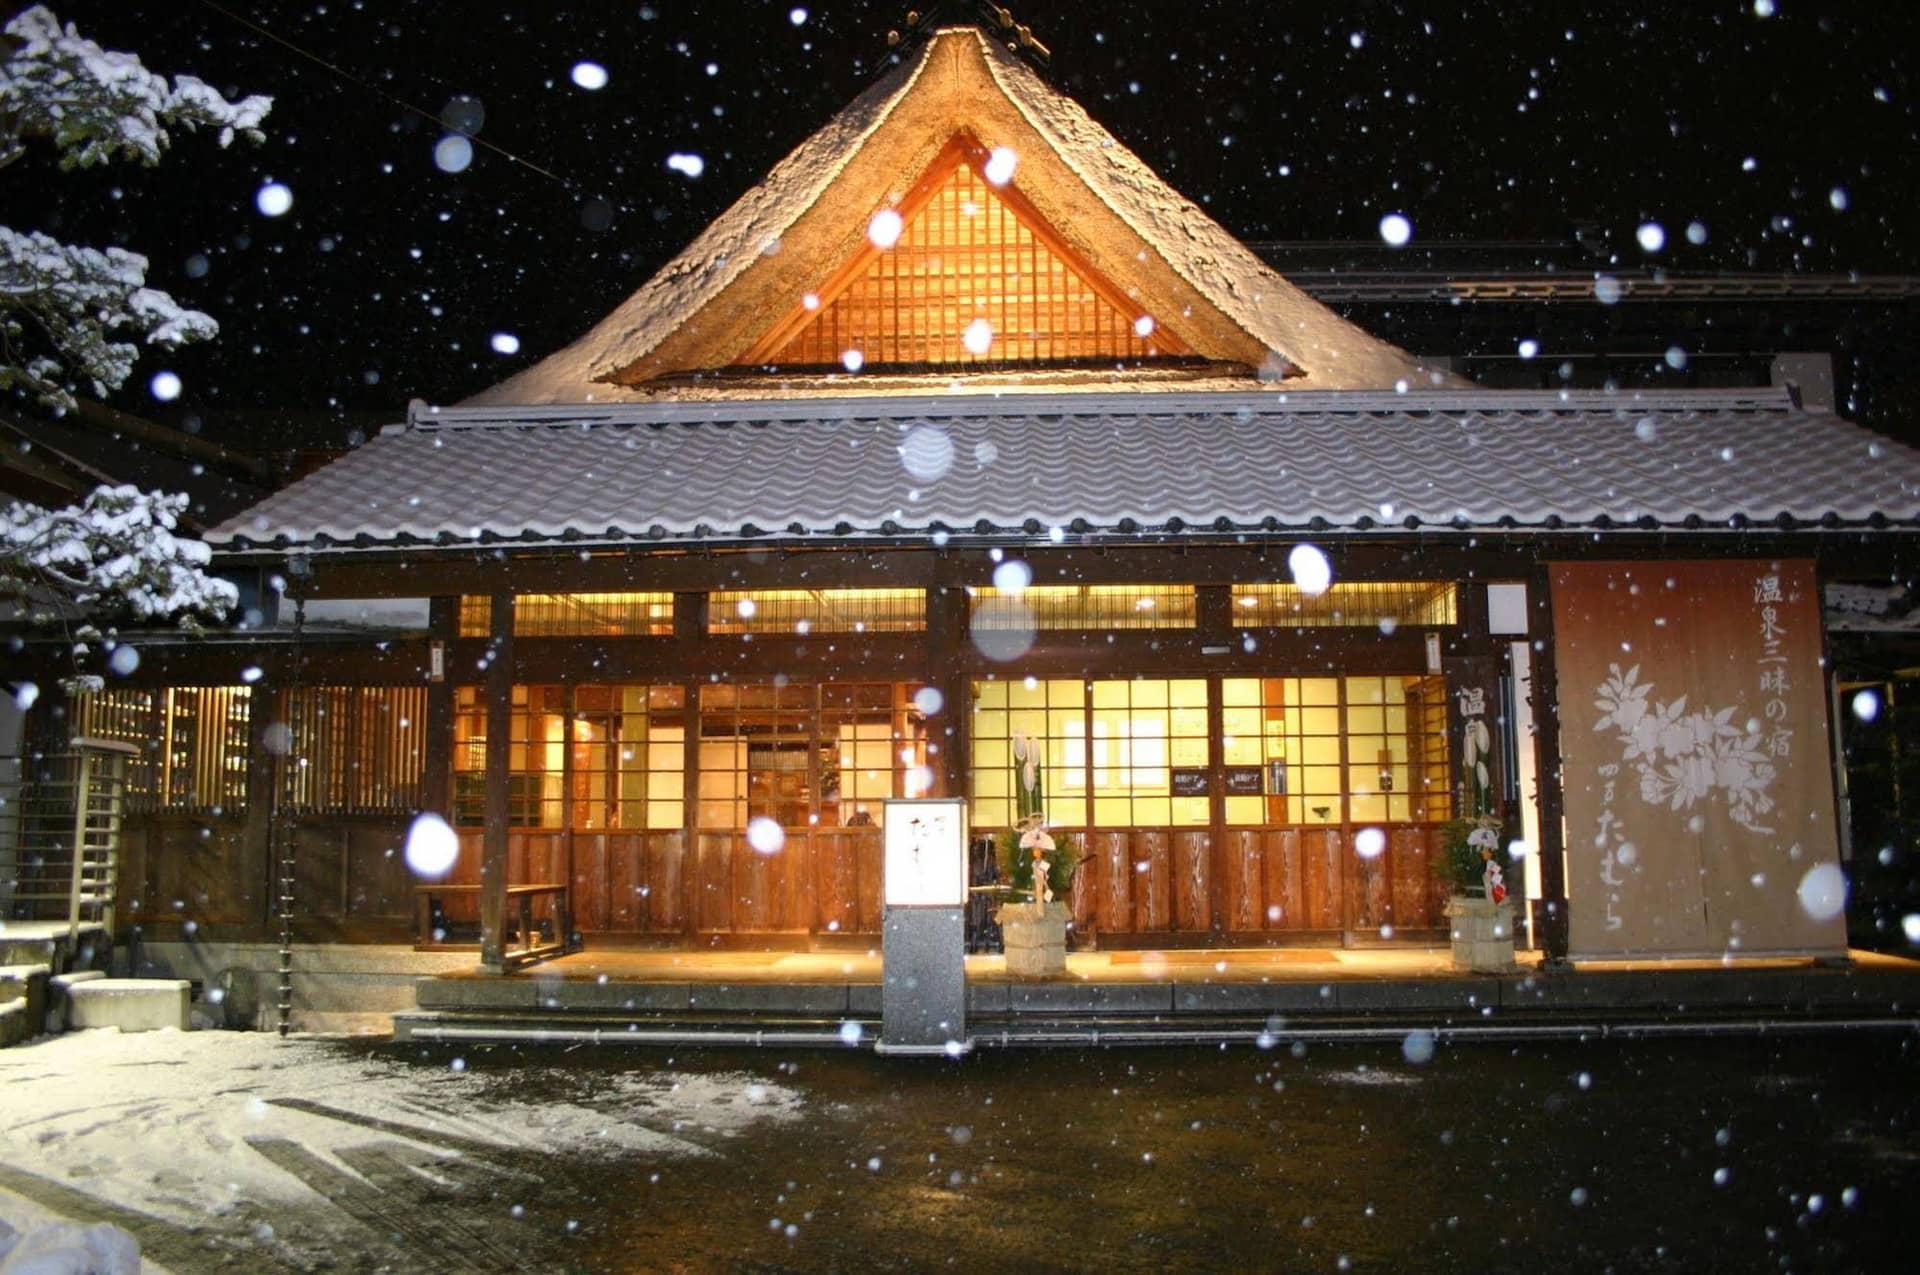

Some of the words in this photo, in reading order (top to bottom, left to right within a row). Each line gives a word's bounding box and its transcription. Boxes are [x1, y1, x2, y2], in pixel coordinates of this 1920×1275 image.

[1754, 577, 1794, 757] 温泉三昧の宿
